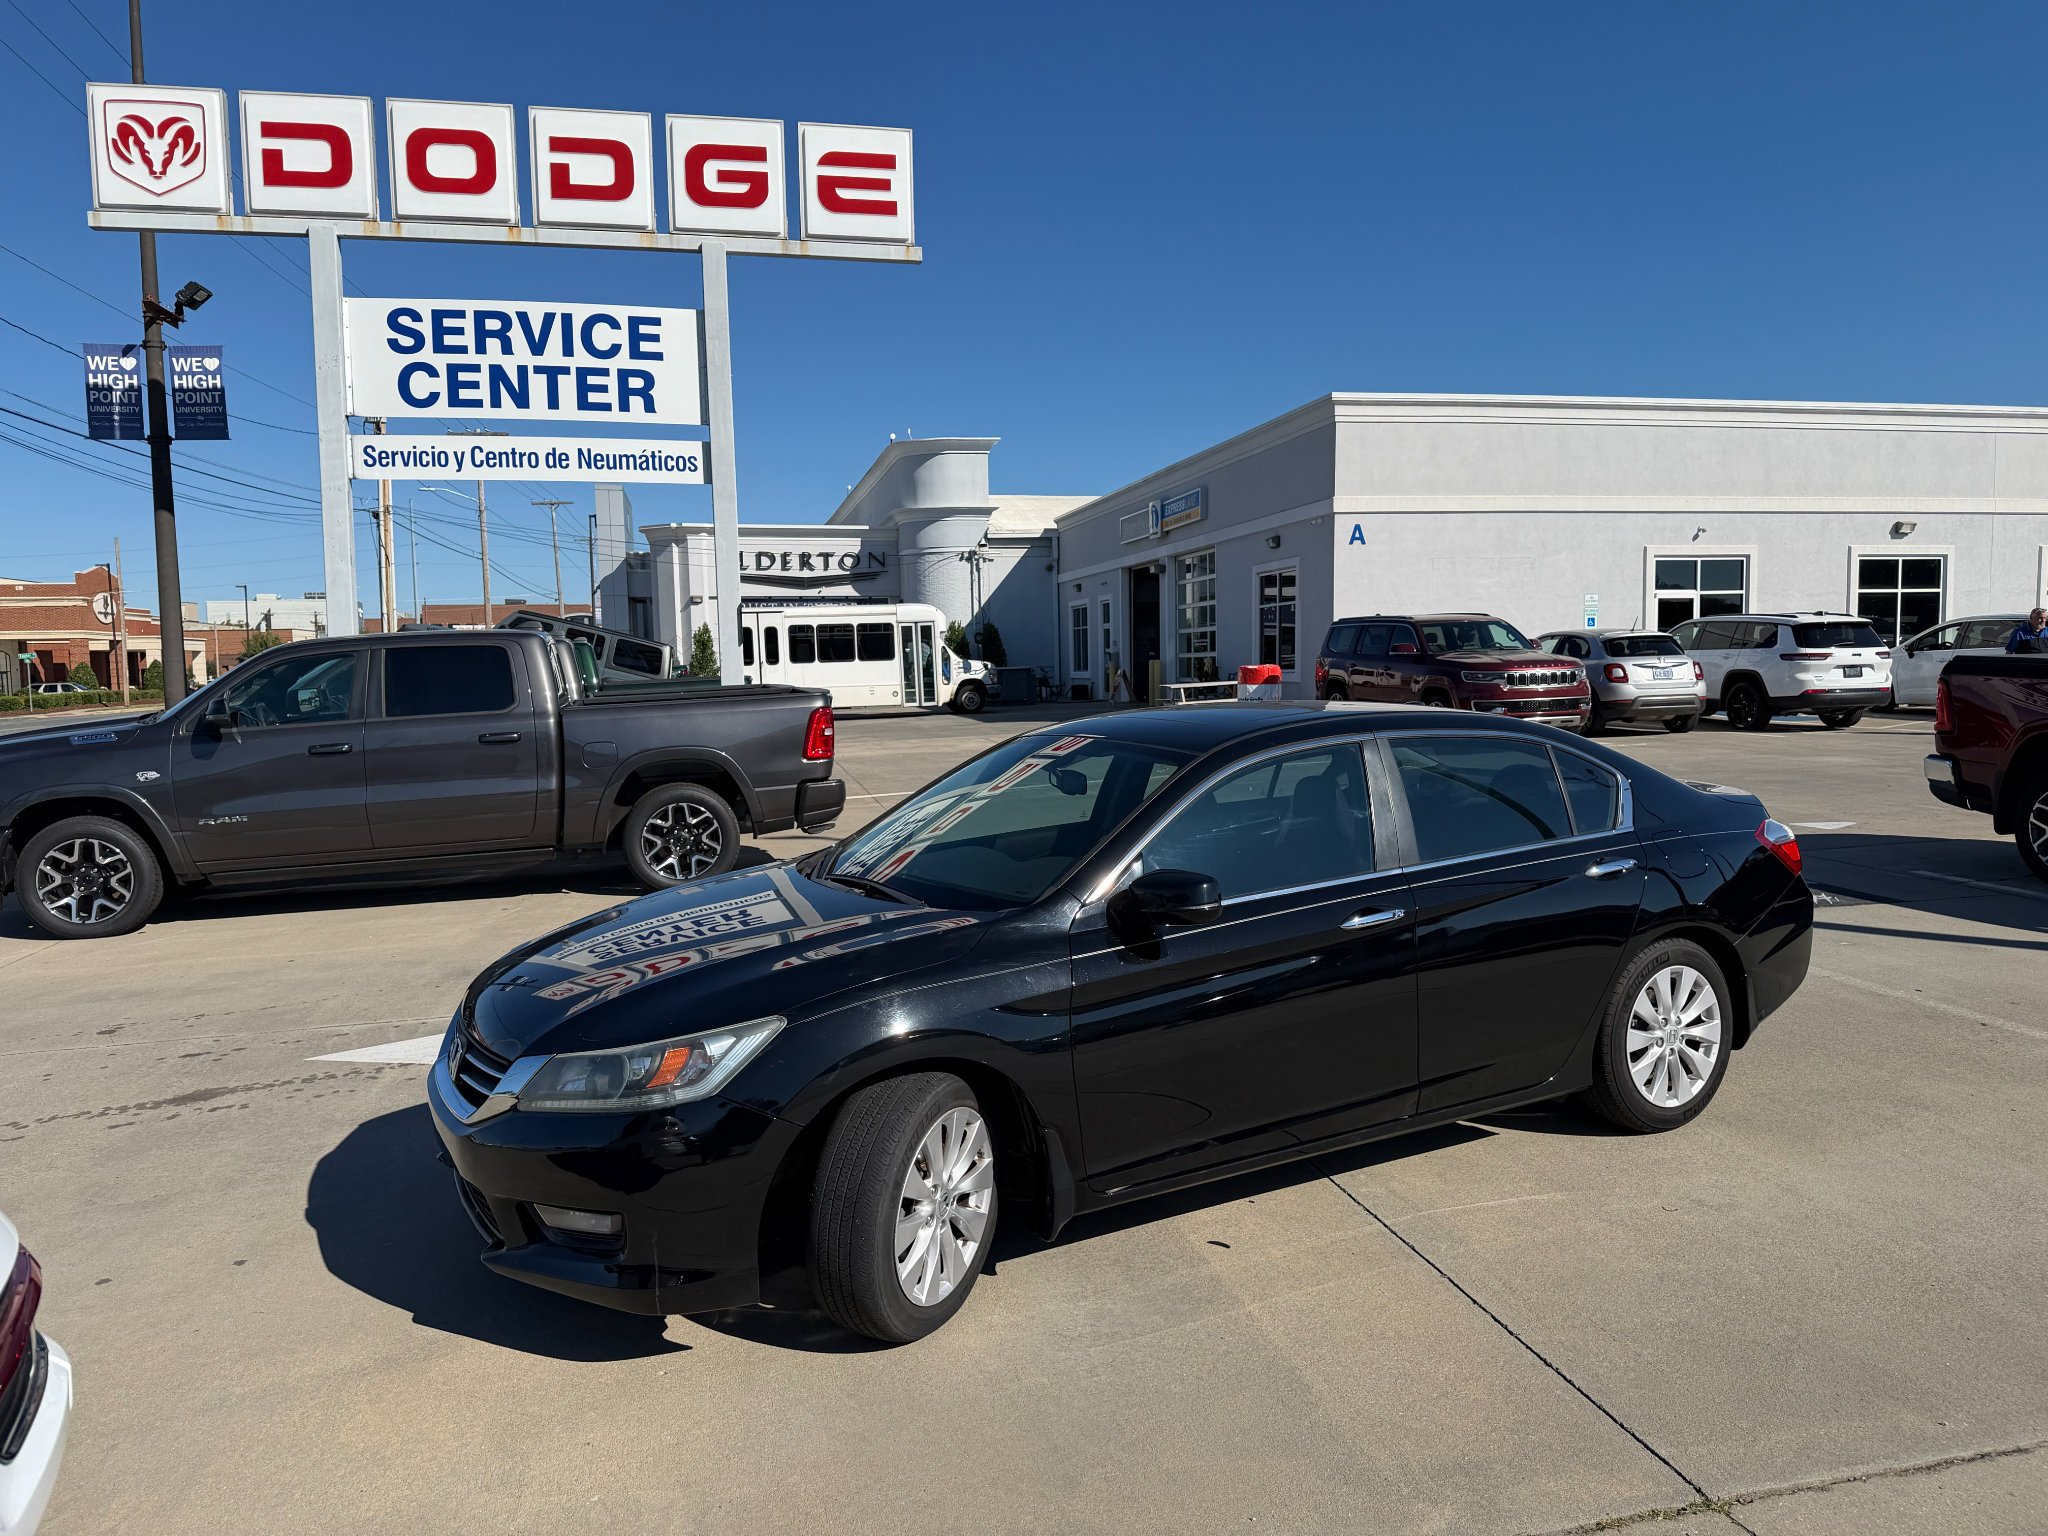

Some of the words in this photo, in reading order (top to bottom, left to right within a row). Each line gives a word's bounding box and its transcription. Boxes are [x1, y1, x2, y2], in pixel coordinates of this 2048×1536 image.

[260, 121, 898, 216] DODGE
[386, 307, 664, 361] SERVICE
[87, 356, 119, 370] WE
[172, 357, 203, 372] WE
[88, 373, 138, 389] HIGH
[173, 374, 221, 389] HIGH
[397, 361, 657, 414] CENTER
[89, 391, 139, 403] POINT
[175, 391, 222, 404] POINT
[89, 405, 140, 413] UNIVERSITY
[175, 406, 223, 414] UNIVERSITY
[362, 444, 449, 467] Servicio
[455, 450, 466, 472] y
[470, 445, 540, 469] Centro
[545, 446, 570, 469] de
[577, 448, 698, 473] Neumáticos
[1348, 523, 1367, 545] A
[739, 551, 886, 572] LDERTON
[199, 815, 248, 825] RAM
